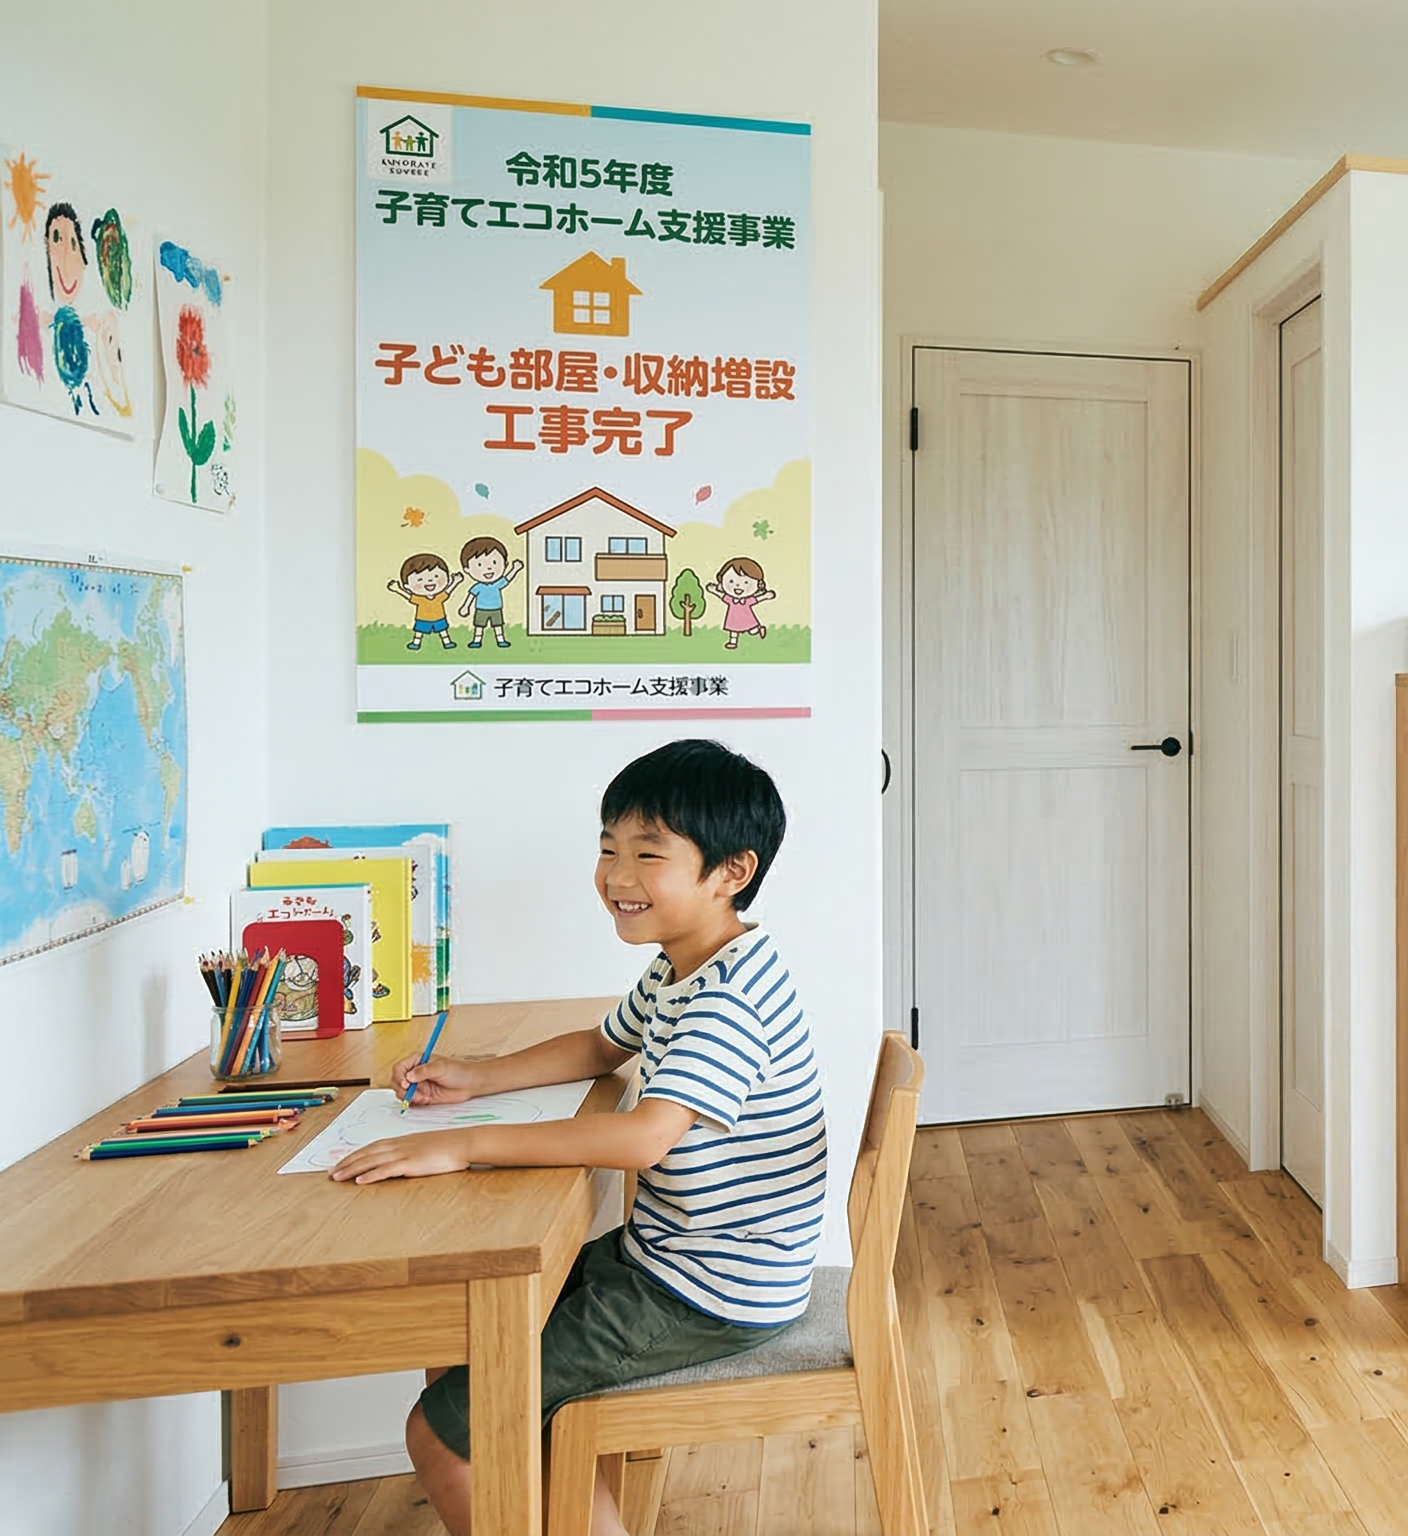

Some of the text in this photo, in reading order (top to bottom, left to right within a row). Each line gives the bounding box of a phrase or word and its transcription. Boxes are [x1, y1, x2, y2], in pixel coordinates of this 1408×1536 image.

[505, 151, 674, 197] 令和5年度
[375, 189, 796, 250] 子育てエコホーム支援事業
[375, 342, 796, 401] 子ども部屋・収納増設
[483, 404, 694, 457] 工事完了
